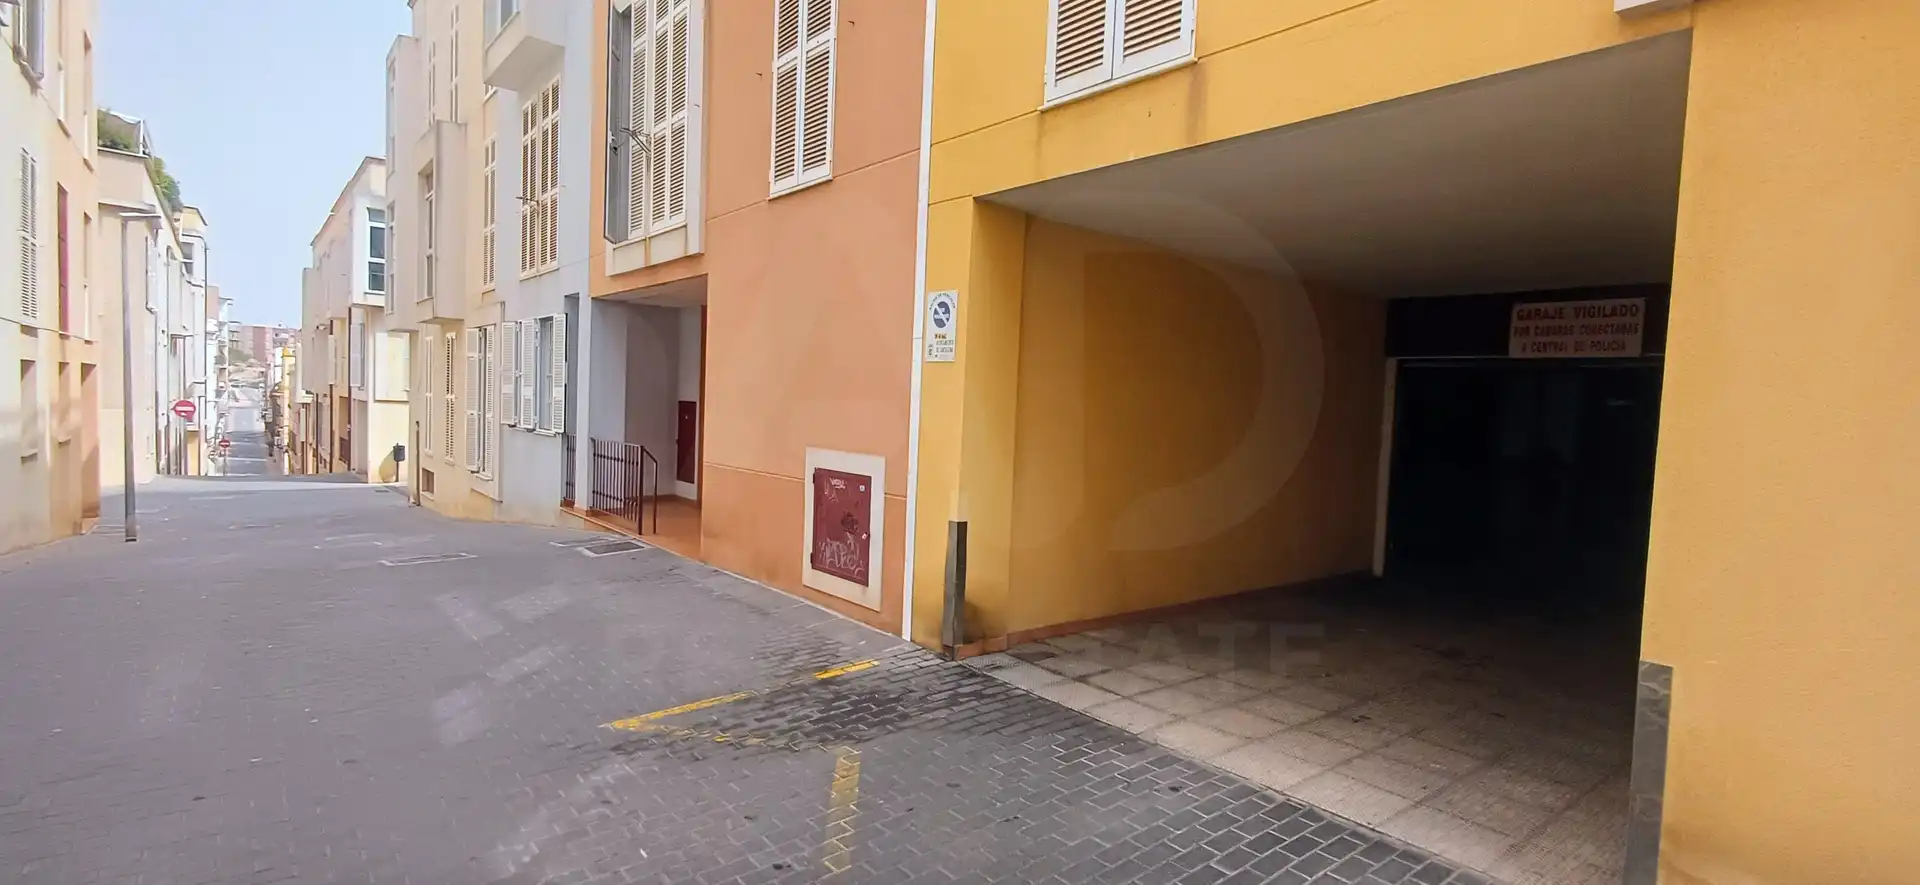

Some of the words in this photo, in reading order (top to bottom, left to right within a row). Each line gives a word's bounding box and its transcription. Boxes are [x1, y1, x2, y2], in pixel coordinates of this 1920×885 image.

[1516, 306, 1566, 321] GARAJE
[1572, 303, 1640, 319] VIGILADO
[1531, 340, 1568, 353] CENTRAL
